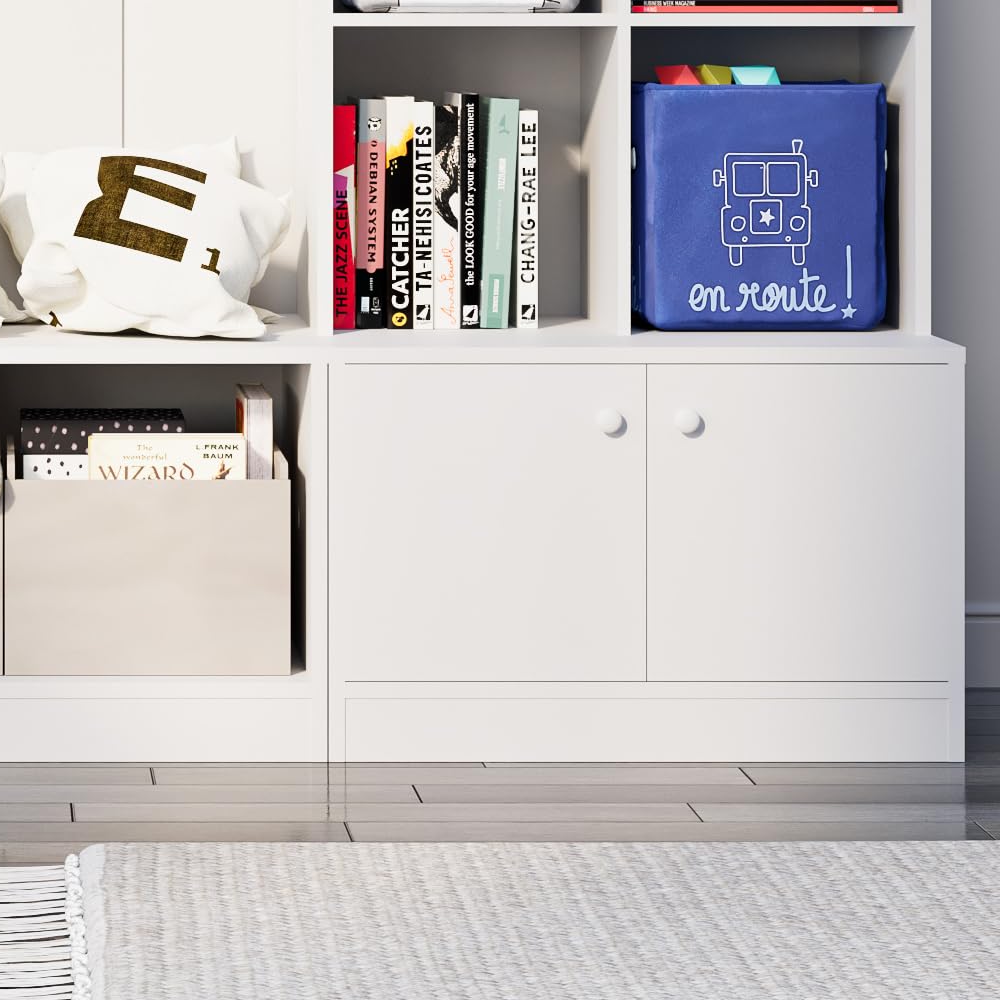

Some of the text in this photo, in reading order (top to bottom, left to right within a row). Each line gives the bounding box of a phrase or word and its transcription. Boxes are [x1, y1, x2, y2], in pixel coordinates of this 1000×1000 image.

[74, 156, 221, 275] E 1
[368, 151, 379, 204] DEBIAN
[415, 125, 432, 292] TA-NEHISI COATES
[465, 103, 477, 286] the LOOK GOOD for your age movement
[520, 123, 537, 284] CHANG-RAE LEE
[335, 189, 348, 318] THE JAZZ SCENE
[367, 208, 378, 263] SYSTEM
[391, 207, 410, 310] CATCHER
[688, 283, 730, 312] en
[98, 461, 196, 480] WIZARD
[122, 453, 168, 461] wonderful
